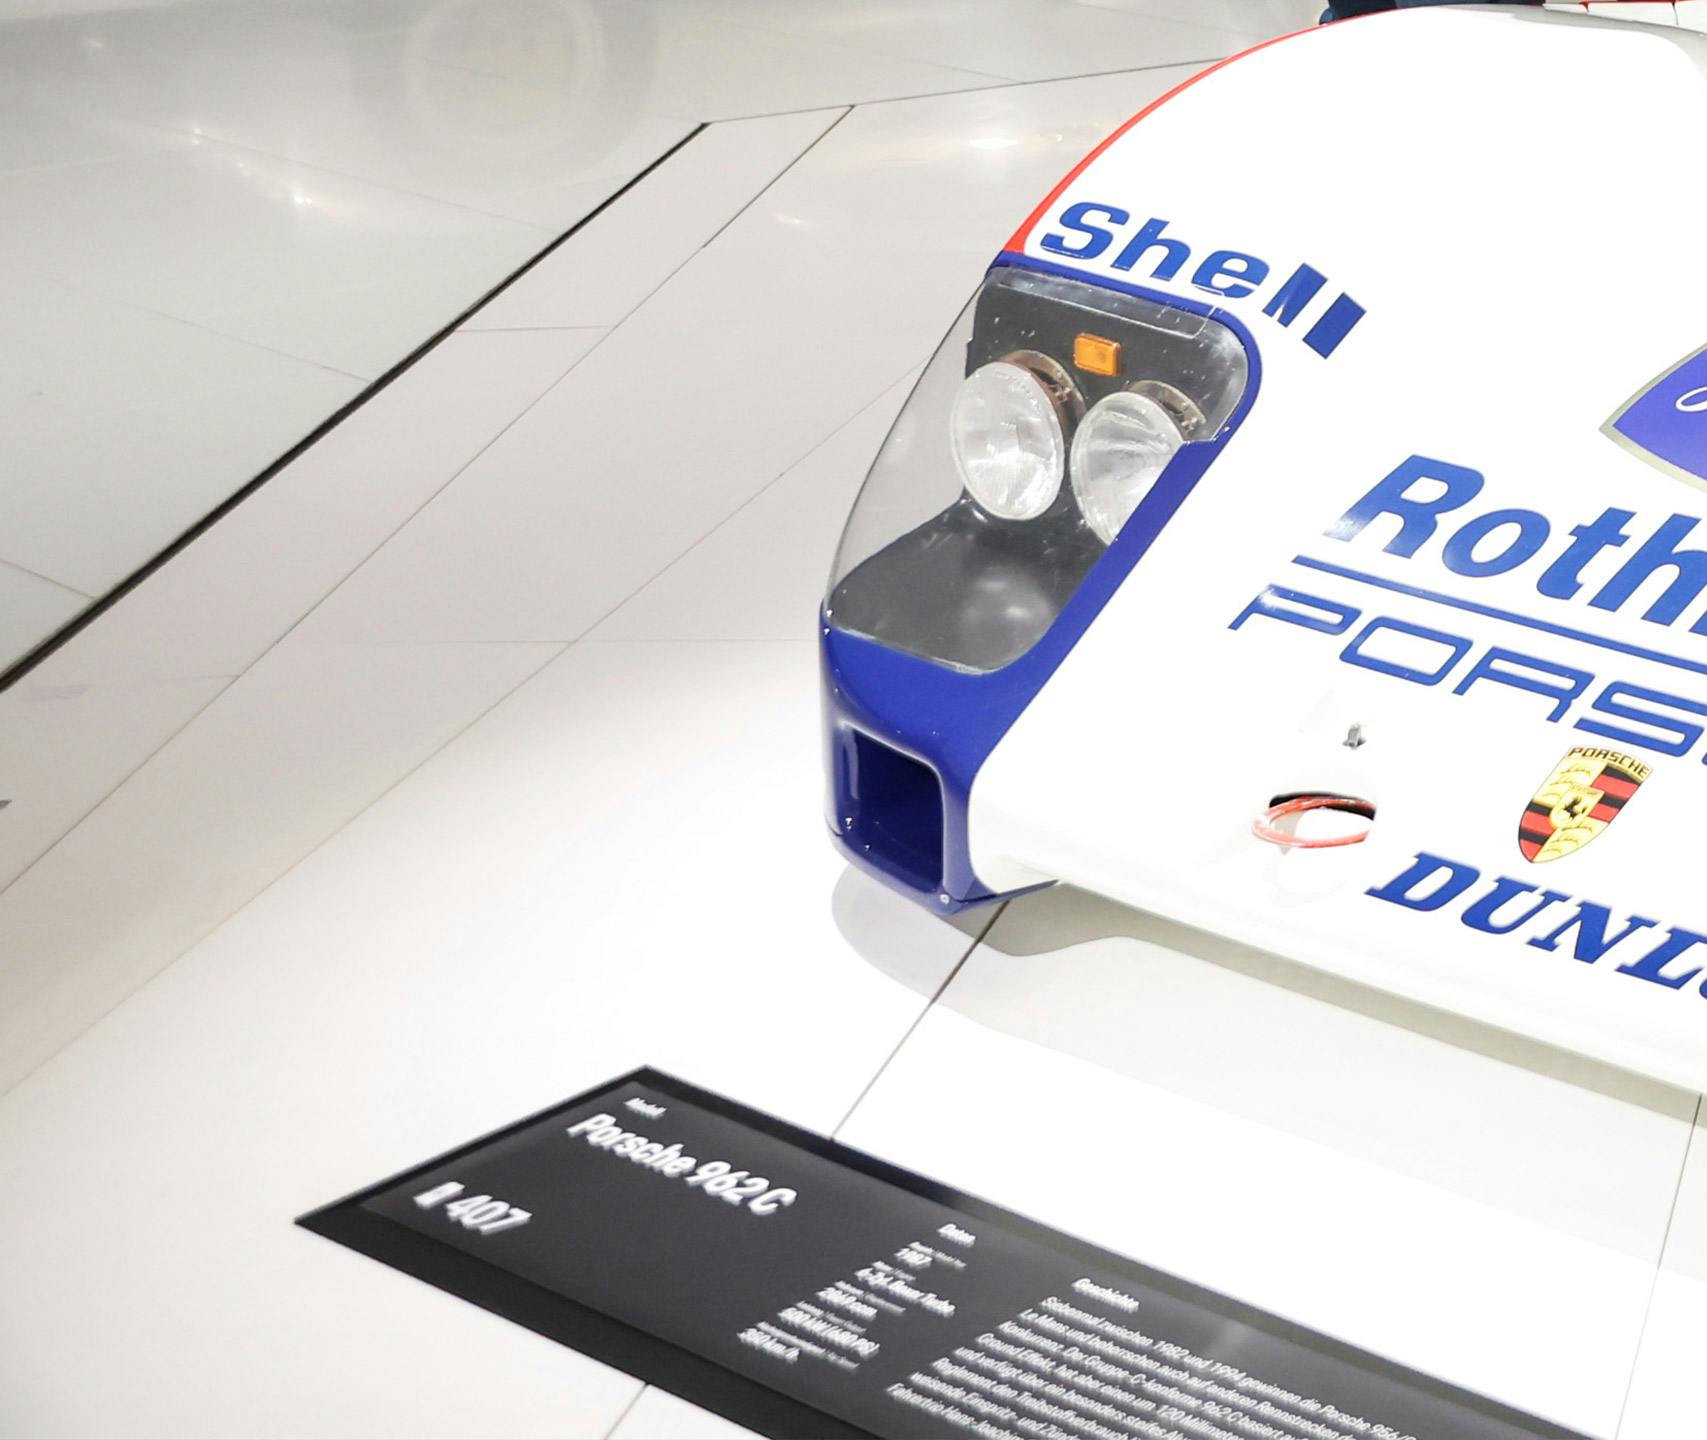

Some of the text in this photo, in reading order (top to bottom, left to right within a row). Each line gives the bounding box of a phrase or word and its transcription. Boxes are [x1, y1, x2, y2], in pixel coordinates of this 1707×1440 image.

[1037, 200, 1367, 359] Shell
[1567, 746, 1650, 777] PORSCHE
[567, 1114, 797, 1215] Porsche 962 C
[446, 1195, 532, 1233] 407
[1072, 1278, 1139, 1312] Geschichte
[888, 1383, 944, 1413] Fahrertrio
[910, 1372, 966, 1401] weisende
[1016, 1417, 1047, 1432] und
[932, 1358, 997, 1390] Reglement
[988, 1384, 1018, 1399] den
[954, 1347, 983, 1362] und
[975, 1356, 1022, 1379] verfügt
[1014, 1372, 1049, 1390] über
[1041, 1384, 1066, 1397] ein
[1059, 1390, 1126, 1421] besonders
[1119, 1416, 1167, 1437] steifes
[977, 1333, 1025, 1357] Ground
[1013, 1349, 1056, 1372] Effekt,
[1053, 1365, 1078, 1380] hat
[1069, 1374, 1105, 1391] aber
[1096, 1385, 1135, 1404] einen
[1154, 1405, 1185, 1422] 120
[1019, 1309, 1038, 1322] Le
[1032, 1315, 1069, 1335] Mans
[1062, 1329, 1098, 1344] und
[1085, 1336, 1160, 1371] beherrschen
[1152, 1366, 1189, 1383] auch
[1182, 1377, 1214, 1391] auf
[1202, 1385, 1257, 1409] anderen
[1251, 1401, 1339, 1440] Rennstrecken
[1040, 1297, 1105, 1327] Siebenmal
[1094, 1321, 1153, 1347] zwischen
[1150, 1341, 1189, 1361] 1982
[1179, 1355, 1214, 1370] und
[1204, 1362, 1247, 1383] 1994
[1235, 1377, 1301, 1405] gewinnen
[1295, 1399, 1321, 1412] die
[1315, 1405, 1371, 1432] Porsche
[1060, 1347, 1088, 1362] Der
[1080, 1356, 1202, 1410] Gruppe-C-konforme
[1196, 1401, 1232, 1418] 962
[1234, 1416, 1284, 1440] basiert
